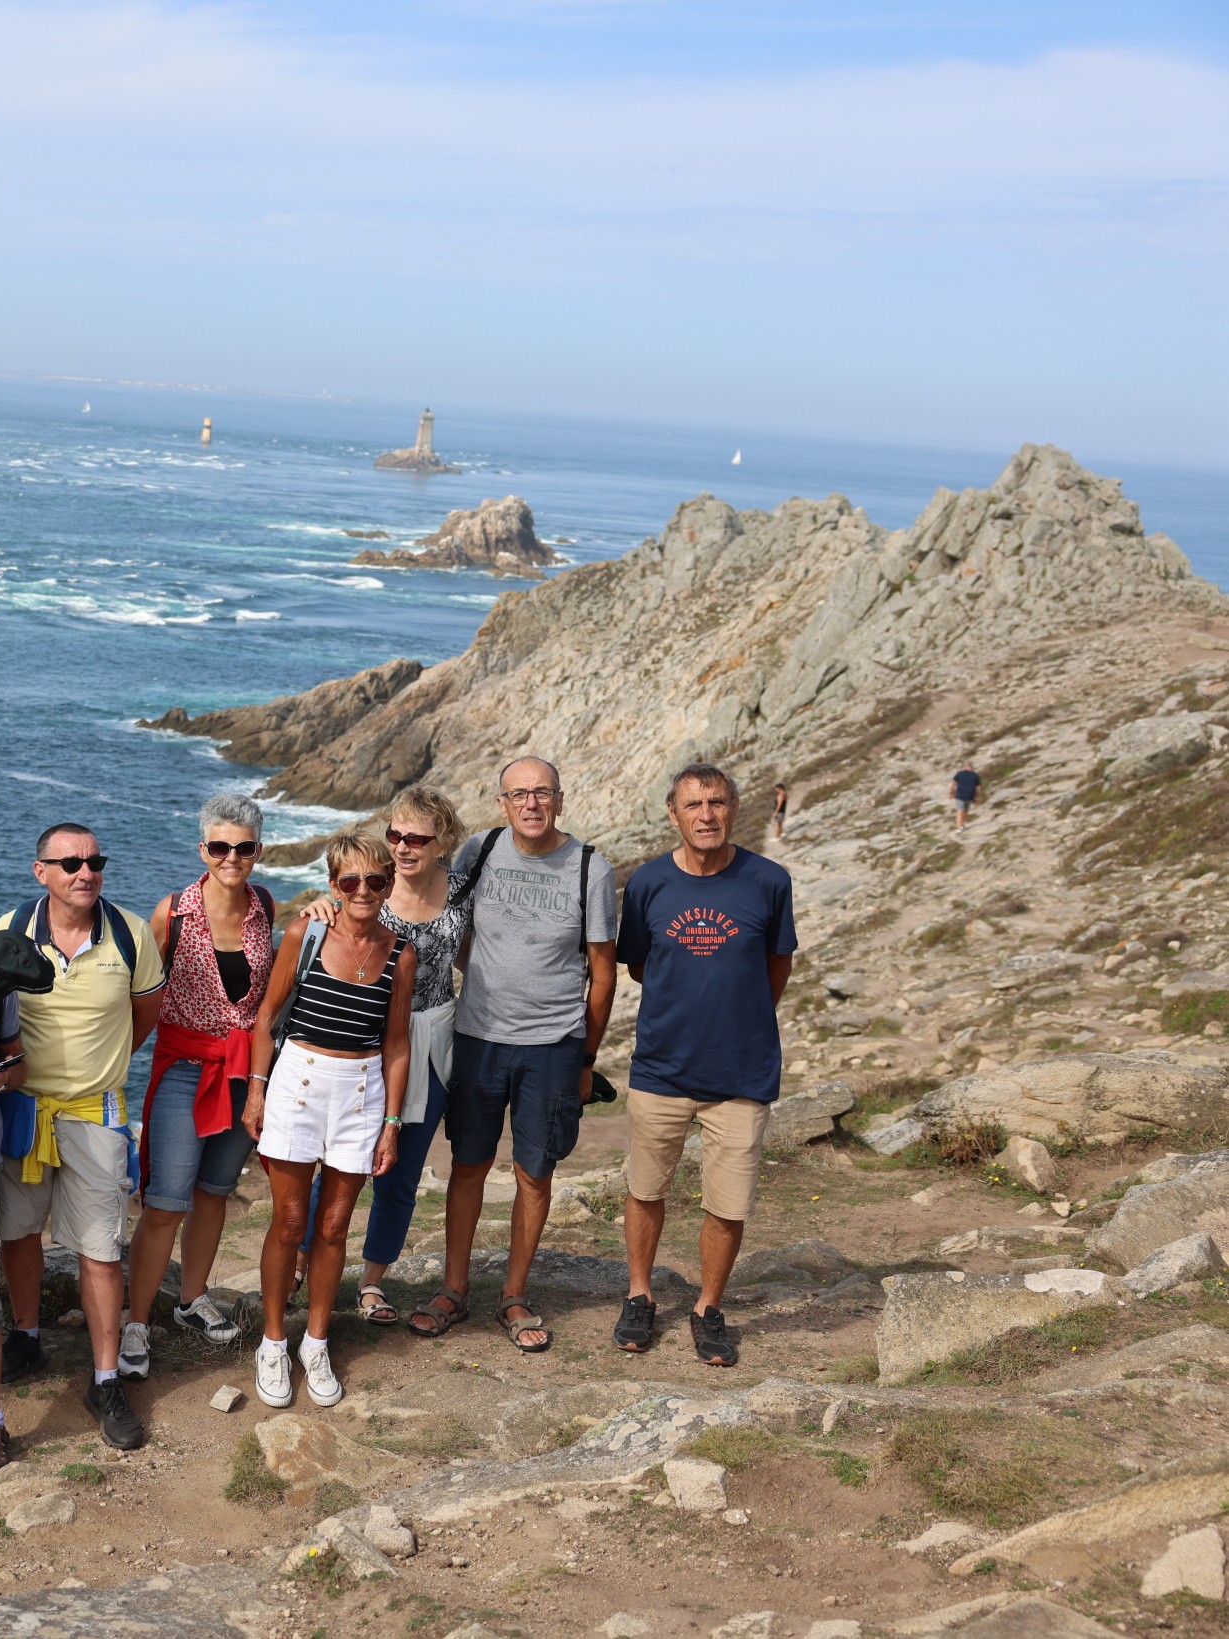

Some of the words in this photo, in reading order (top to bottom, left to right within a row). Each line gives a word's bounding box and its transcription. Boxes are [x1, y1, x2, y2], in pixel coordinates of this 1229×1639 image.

[497, 870, 522, 880] JULES
[507, 885, 571, 911] DISTRICT
[666, 908, 739, 937] QUIKSILVER
[685, 927, 718, 935] ORIGINAL
[678, 936, 694, 944] SURF
[696, 936, 727, 944] COMPANY
